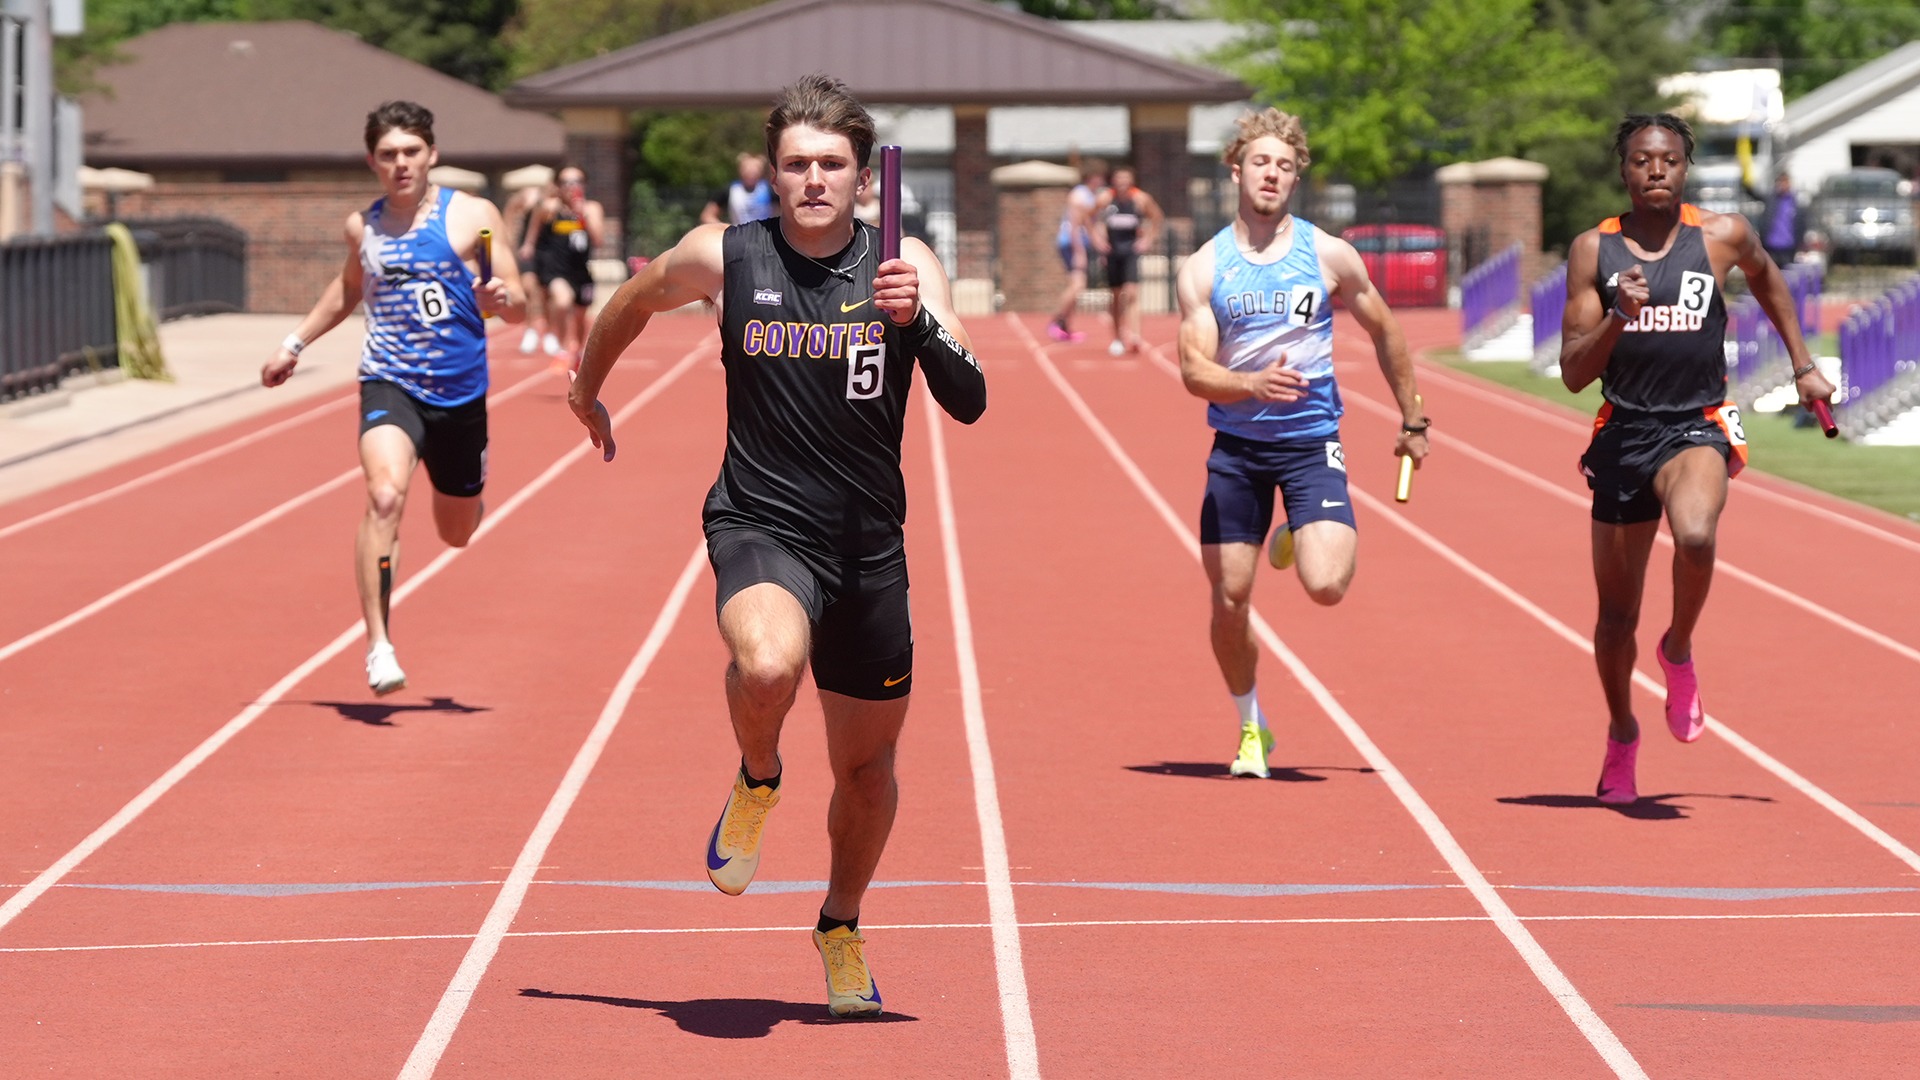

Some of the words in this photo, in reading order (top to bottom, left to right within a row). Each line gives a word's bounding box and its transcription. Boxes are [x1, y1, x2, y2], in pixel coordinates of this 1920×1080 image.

[422, 288, 442, 317] 6
[1225, 290, 1292, 321] COLB
[1294, 291, 1314, 324] 4
[1684, 277, 1706, 312] 3
[743, 319, 885, 359] COYOTES
[852, 349, 880, 396] 5
[1728, 410, 1745, 440] 3
